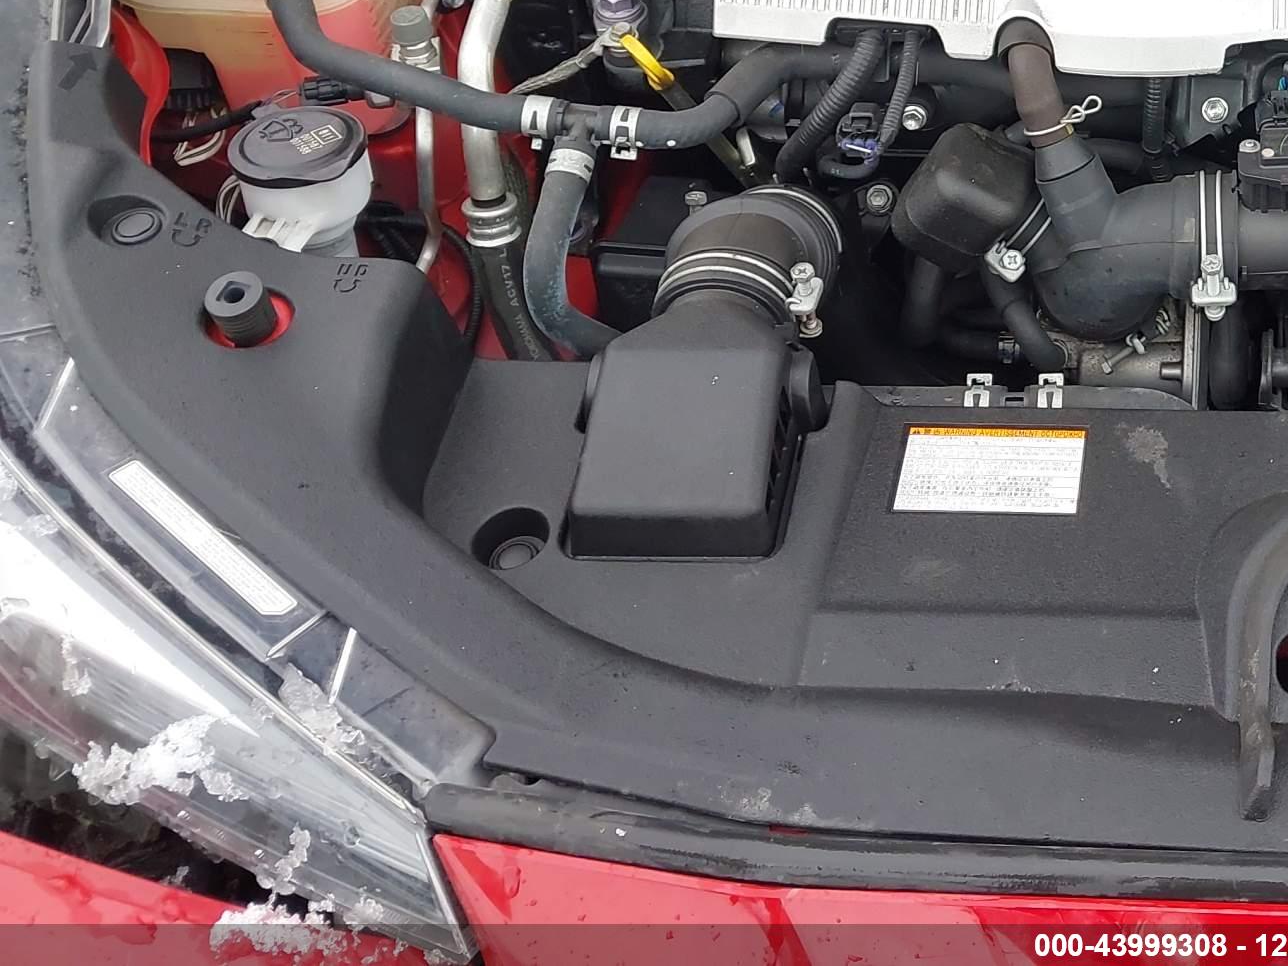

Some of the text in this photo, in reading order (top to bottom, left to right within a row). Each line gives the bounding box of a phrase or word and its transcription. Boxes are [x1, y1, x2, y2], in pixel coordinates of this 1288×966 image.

[501, 265, 520, 307] ACV17
[514, 314, 540, 361] YOKOHAMA
[944, 428, 977, 436] WARNING
[979, 429, 1037, 438] AVERTISSEMENT
